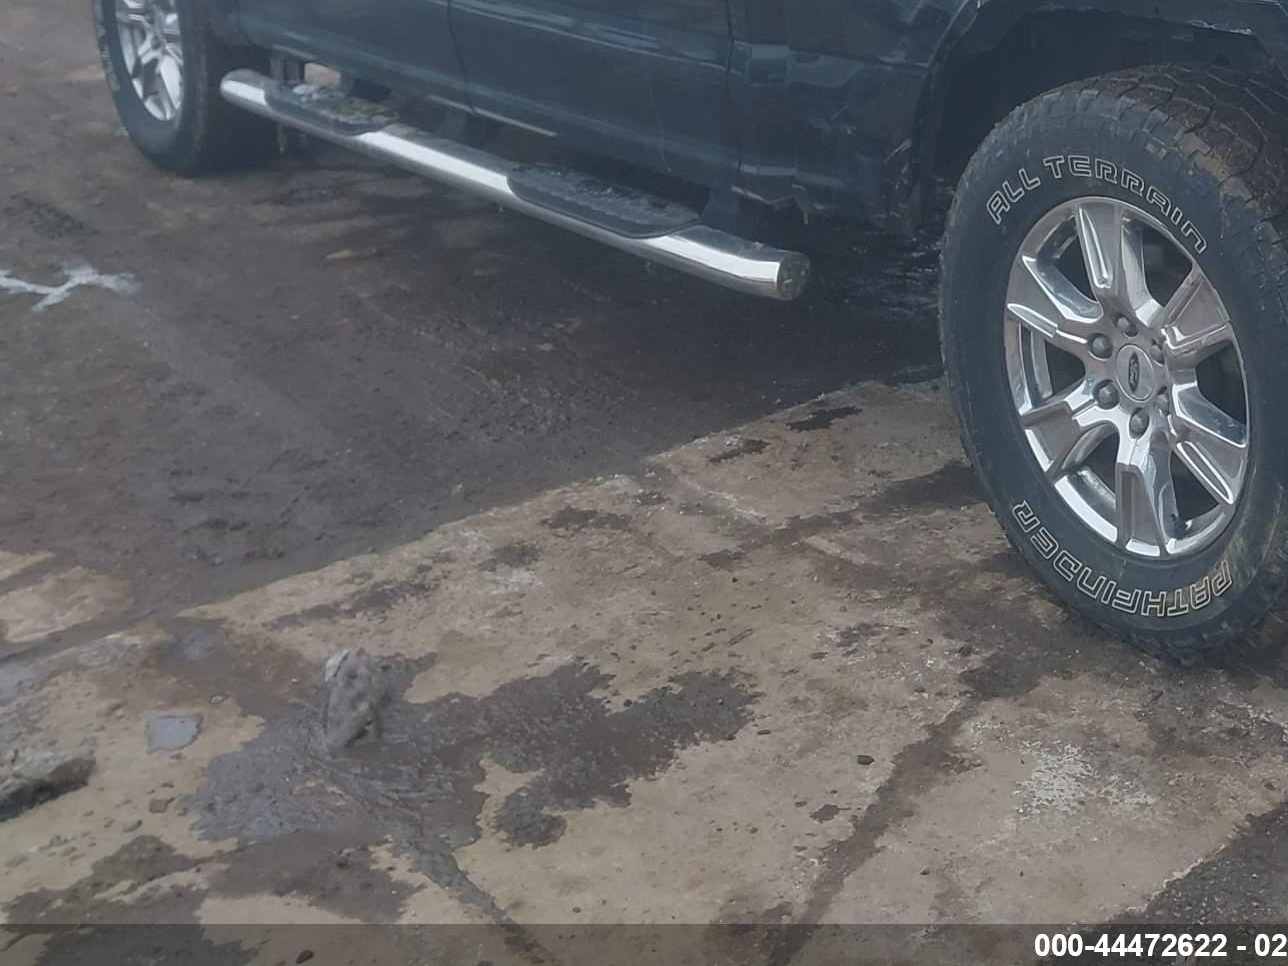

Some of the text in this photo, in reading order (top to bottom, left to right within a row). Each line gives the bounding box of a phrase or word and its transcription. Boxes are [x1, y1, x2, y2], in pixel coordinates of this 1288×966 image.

[985, 154, 1208, 254] ALL TERRAIN
[1012, 499, 1233, 617] PATHFINDER
